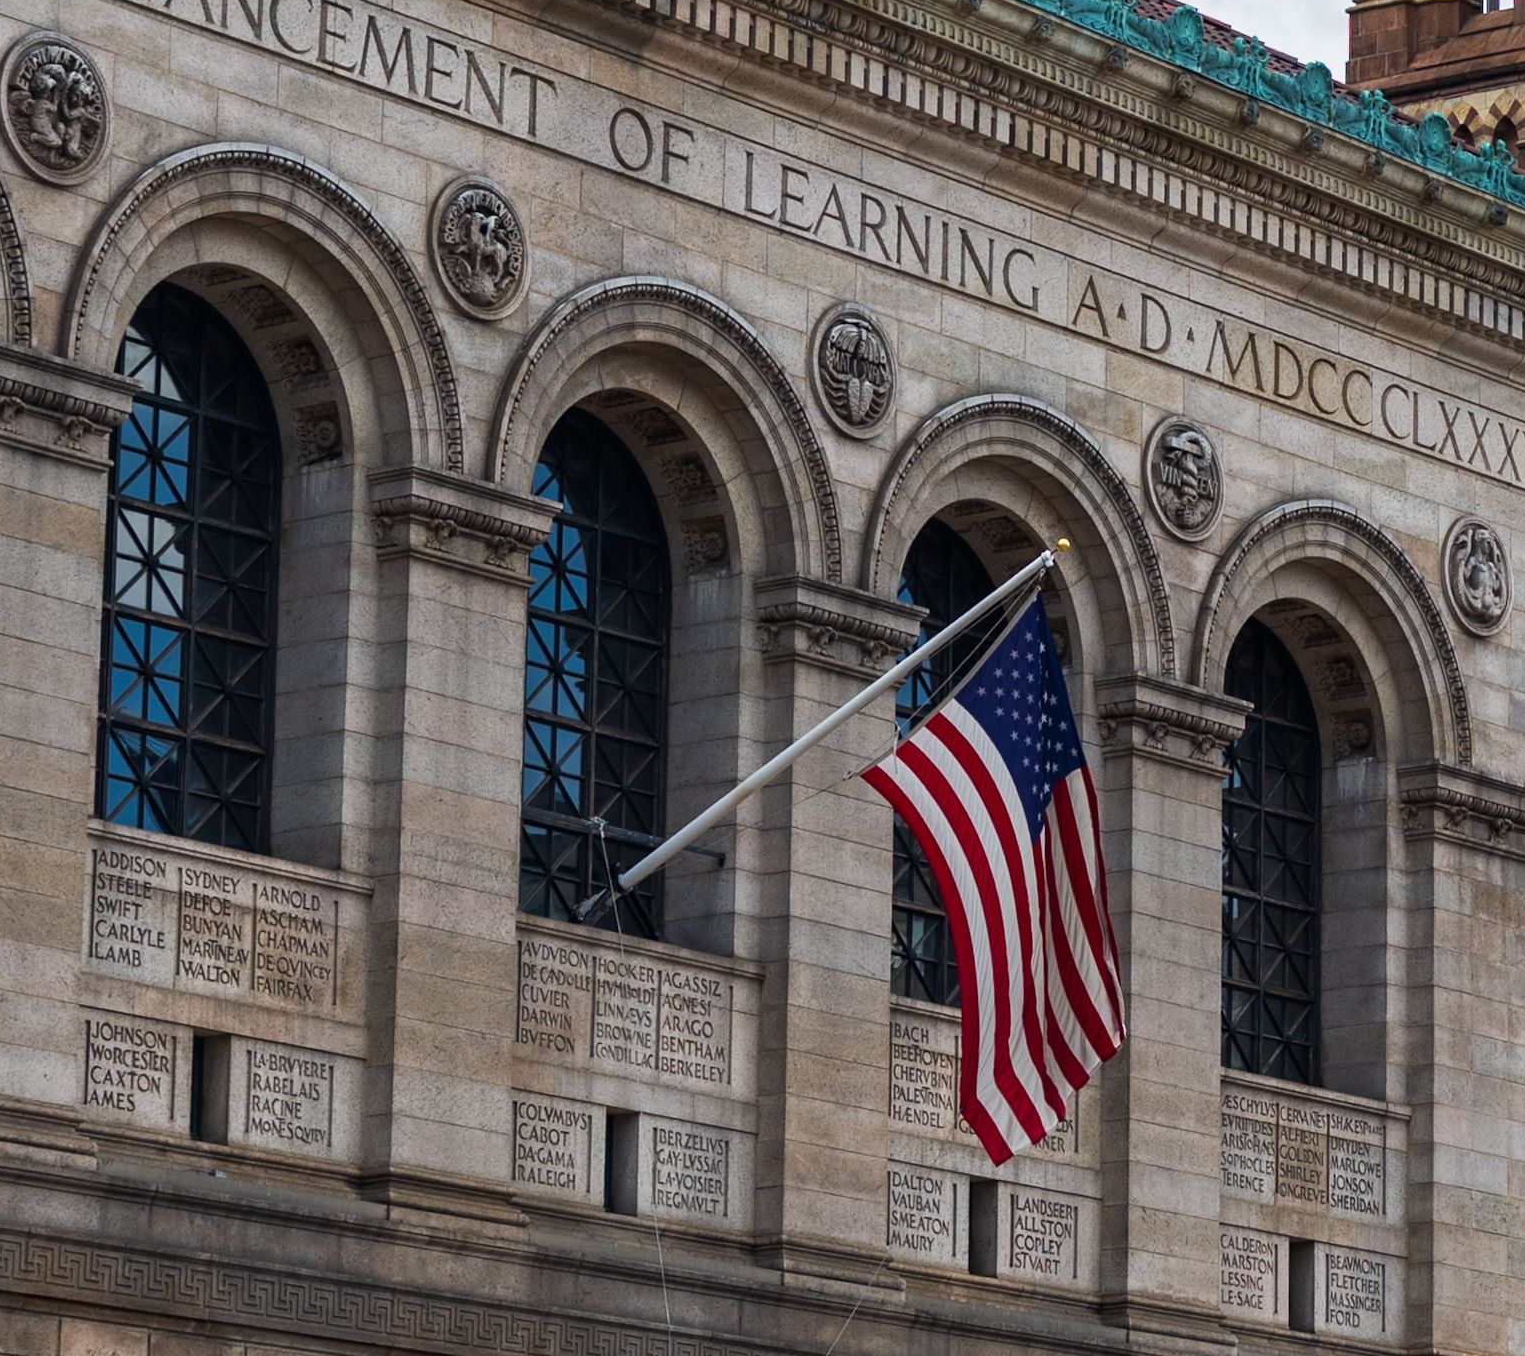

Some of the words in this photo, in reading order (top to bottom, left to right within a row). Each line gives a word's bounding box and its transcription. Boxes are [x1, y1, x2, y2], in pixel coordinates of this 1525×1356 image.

[609, 107, 696, 185] OF
[743, 152, 1041, 312] LEARNING
[98, 850, 166, 878] ADDISON
[97, 872, 152, 899] STEELE
[185, 868, 240, 894] SYDNEY
[96, 896, 142, 920] SWIFT
[184, 891, 231, 916] DEFOE
[259, 886, 321, 911] ARNOLD
[95, 919, 165, 949] CARLYLE
[183, 915, 242, 941] BUNYAN
[258, 909, 323, 935] ASCHAM
[95, 942, 142, 967] LAMB
[258, 930, 330, 958] CHAPMAN
[522, 942, 589, 969] AVDVBON
[181, 960, 241, 986] WALTON
[598, 958, 655, 984] HOOKER
[257, 976, 313, 1001] FAIRFAX
[522, 984, 570, 1009] CUVIER
[663, 972, 721, 997] AGASSIZ
[662, 994, 711, 1017] AGNESI
[521, 1006, 572, 1031] DARWIN
[662, 1016, 714, 1039] ARAGO
[92, 1022, 167, 1050] JOHNSON
[521, 1028, 575, 1055] BVFFON
[596, 1023, 652, 1049] BROWNE
[894, 1024, 929, 1044] BACH
[91, 1043, 169, 1074] WORCESTER
[661, 1036, 725, 1063] BENTHAM
[90, 1065, 161, 1094] CAXTON
[661, 1057, 725, 1083] BERKELEY
[893, 1064, 952, 1090] CHERVBINI
[253, 1073, 320, 1101] RABELAIS
[89, 1090, 136, 1112] AMES
[252, 1095, 302, 1120] RACINE
[519, 1102, 587, 1130] COLVMBVS
[519, 1123, 570, 1146] CABOT
[659, 1129, 723, 1156] BERZELIVS
[1330, 1137, 1371, 1157] DRYDEN
[1221, 1151, 1274, 1175] SOPHOCLES
[1279, 1162, 1323, 1185] SHIRLEY
[1331, 1155, 1381, 1178] MARLOWE
[517, 1165, 576, 1190] RALEIGH
[892, 1171, 942, 1195] DALTON
[1220, 1168, 1265, 1193] TERENCE
[1332, 1174, 1374, 1196] JONSON
[657, 1189, 719, 1215] REGNAVLT
[892, 1190, 940, 1214] VAUBAN
[1016, 1195, 1073, 1220] LANDSEER
[1330, 1192, 1380, 1216] SHERIDAN
[891, 1211, 950, 1236] SMEATON
[1015, 1215, 1072, 1239] ALLSTON
[891, 1230, 935, 1252] MAURY
[1015, 1234, 1063, 1256] COPLEY
[1220, 1234, 1273, 1255] CALDERON
[1015, 1252, 1061, 1275] STVART
[1221, 1253, 1274, 1274] MARSTON
[1330, 1254, 1381, 1277] BEAVMONT
[1221, 1270, 1263, 1292] LESSING
[1331, 1273, 1380, 1295] FLETCHER
[1330, 1292, 1383, 1314] MASSINGER
[1330, 1310, 1360, 1328] FORD
